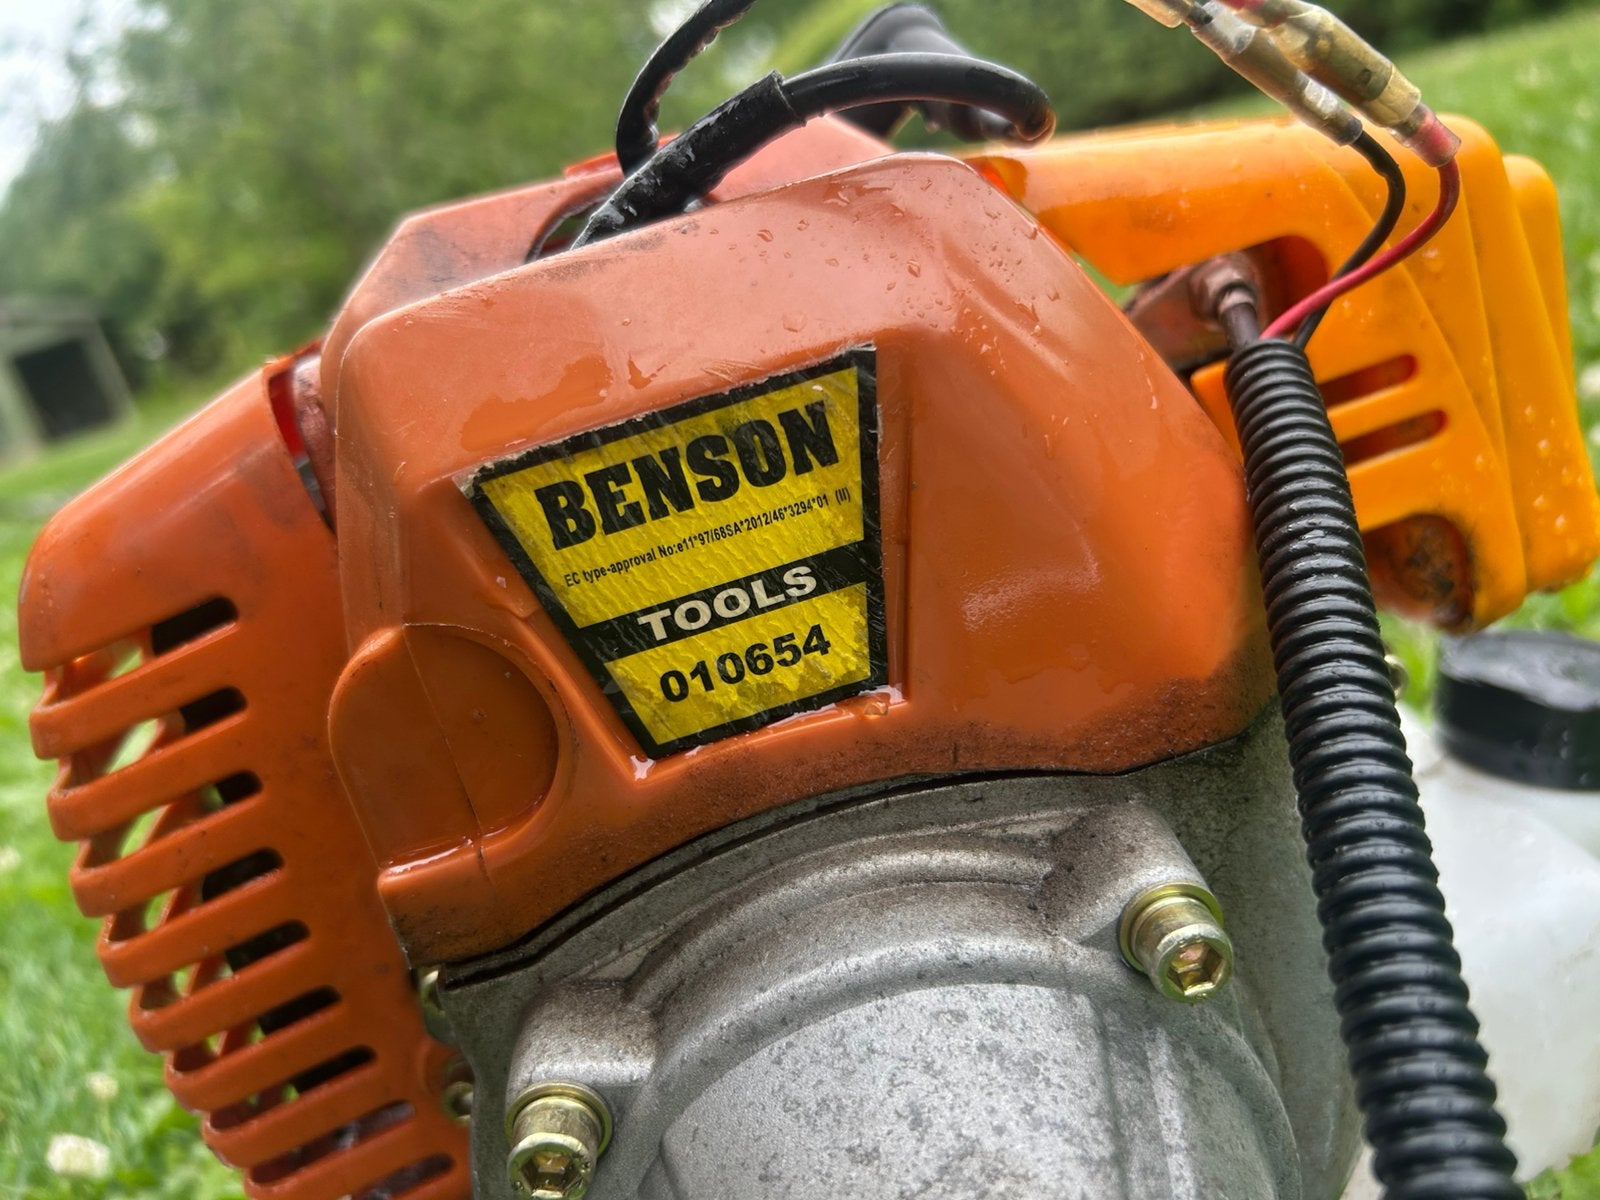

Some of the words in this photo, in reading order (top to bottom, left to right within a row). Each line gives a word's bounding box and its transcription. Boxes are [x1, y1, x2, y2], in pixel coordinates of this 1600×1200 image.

[534, 400, 839, 551] BENSON
[564, 571, 581, 588] EC
[582, 548, 657, 584] type-approval
[638, 566, 817, 641] TOOLS
[659, 624, 831, 702] 010654
